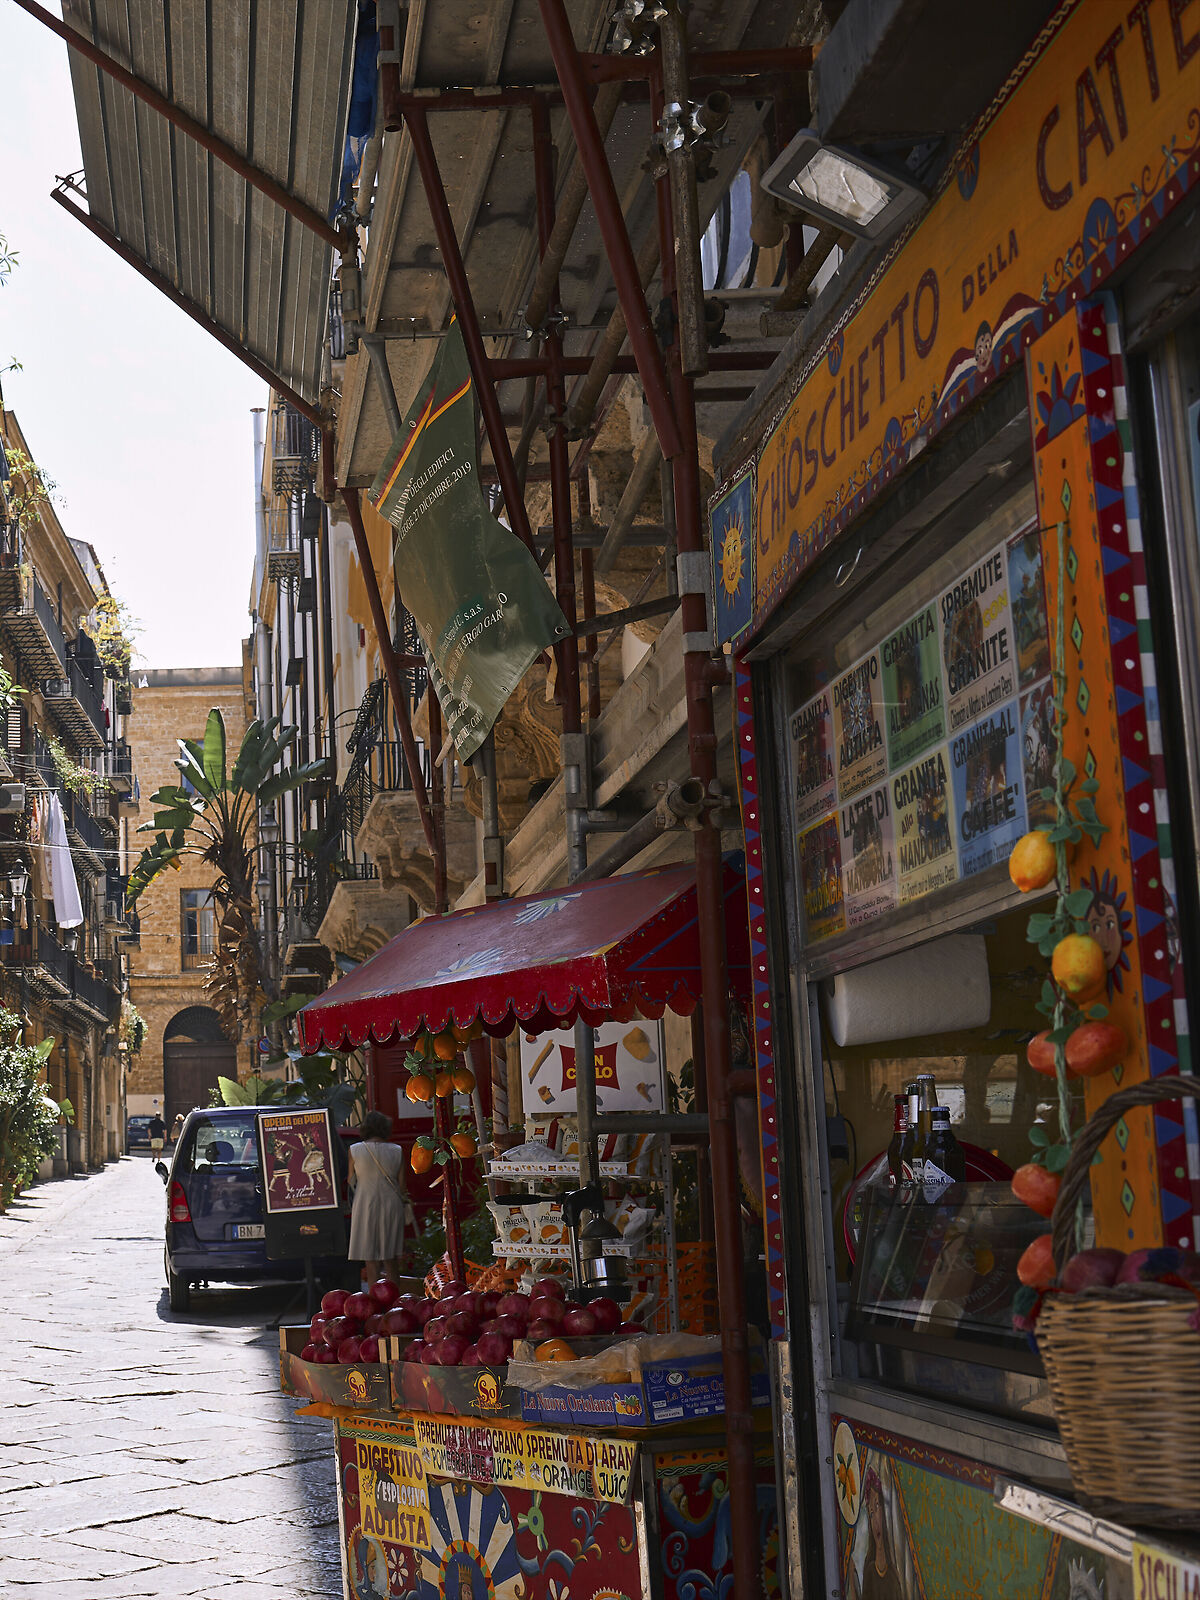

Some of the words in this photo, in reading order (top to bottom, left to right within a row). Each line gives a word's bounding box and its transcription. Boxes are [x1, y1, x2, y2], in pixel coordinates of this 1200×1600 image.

[759, 267, 940, 556] CHIOSCHETTO
[962, 228, 1018, 313] DELLA
[409, 473, 428, 497] DEGLI
[427, 447, 455, 478] EDIFICI
[413, 508, 421, 522] 27
[418, 476, 453, 514] DICEMBRE
[451, 461, 472, 482] 2019
[463, 603, 483, 621] s.a.s.
[941, 552, 1003, 624] SPREMUTE
[982, 589, 1008, 628] CON
[883, 608, 936, 668] GRANITA
[948, 627, 1008, 696] GRANITE
[833, 655, 878, 708] DIGESTIVO
[791, 694, 831, 741] GRANITA
[953, 717, 996, 768] GRANITA
[1000, 708, 1016, 739] AL
[894, 752, 947, 810] GRANITA
[842, 794, 874, 838] LATTE
[875, 787, 889, 821] DI
[900, 821, 952, 873] MANDORLA
[566, 1066, 613, 1080] CLO
[264, 1116, 292, 1128] OPERA
[304, 1113, 325, 1125] PUPI
[239, 1226, 252, 1237] BN
[523, 1391, 537, 1410] La
[536, 1392, 567, 1412] Nuova
[567, 1393, 615, 1413] Ortolana
[358, 1443, 423, 1481] DIGESTIVO
[417, 1421, 457, 1448] SPREMUTA
[459, 1426, 468, 1448] DI
[469, 1427, 524, 1456] MELOGRANO
[431, 1447, 486, 1476] POMEGRANATE
[526, 1434, 584, 1465] SPREMUTA
[585, 1441, 598, 1466] DI
[602, 1444, 633, 1471] ARAN
[543, 1464, 594, 1494] ORANGE
[363, 1505, 429, 1546] AUTISTA
